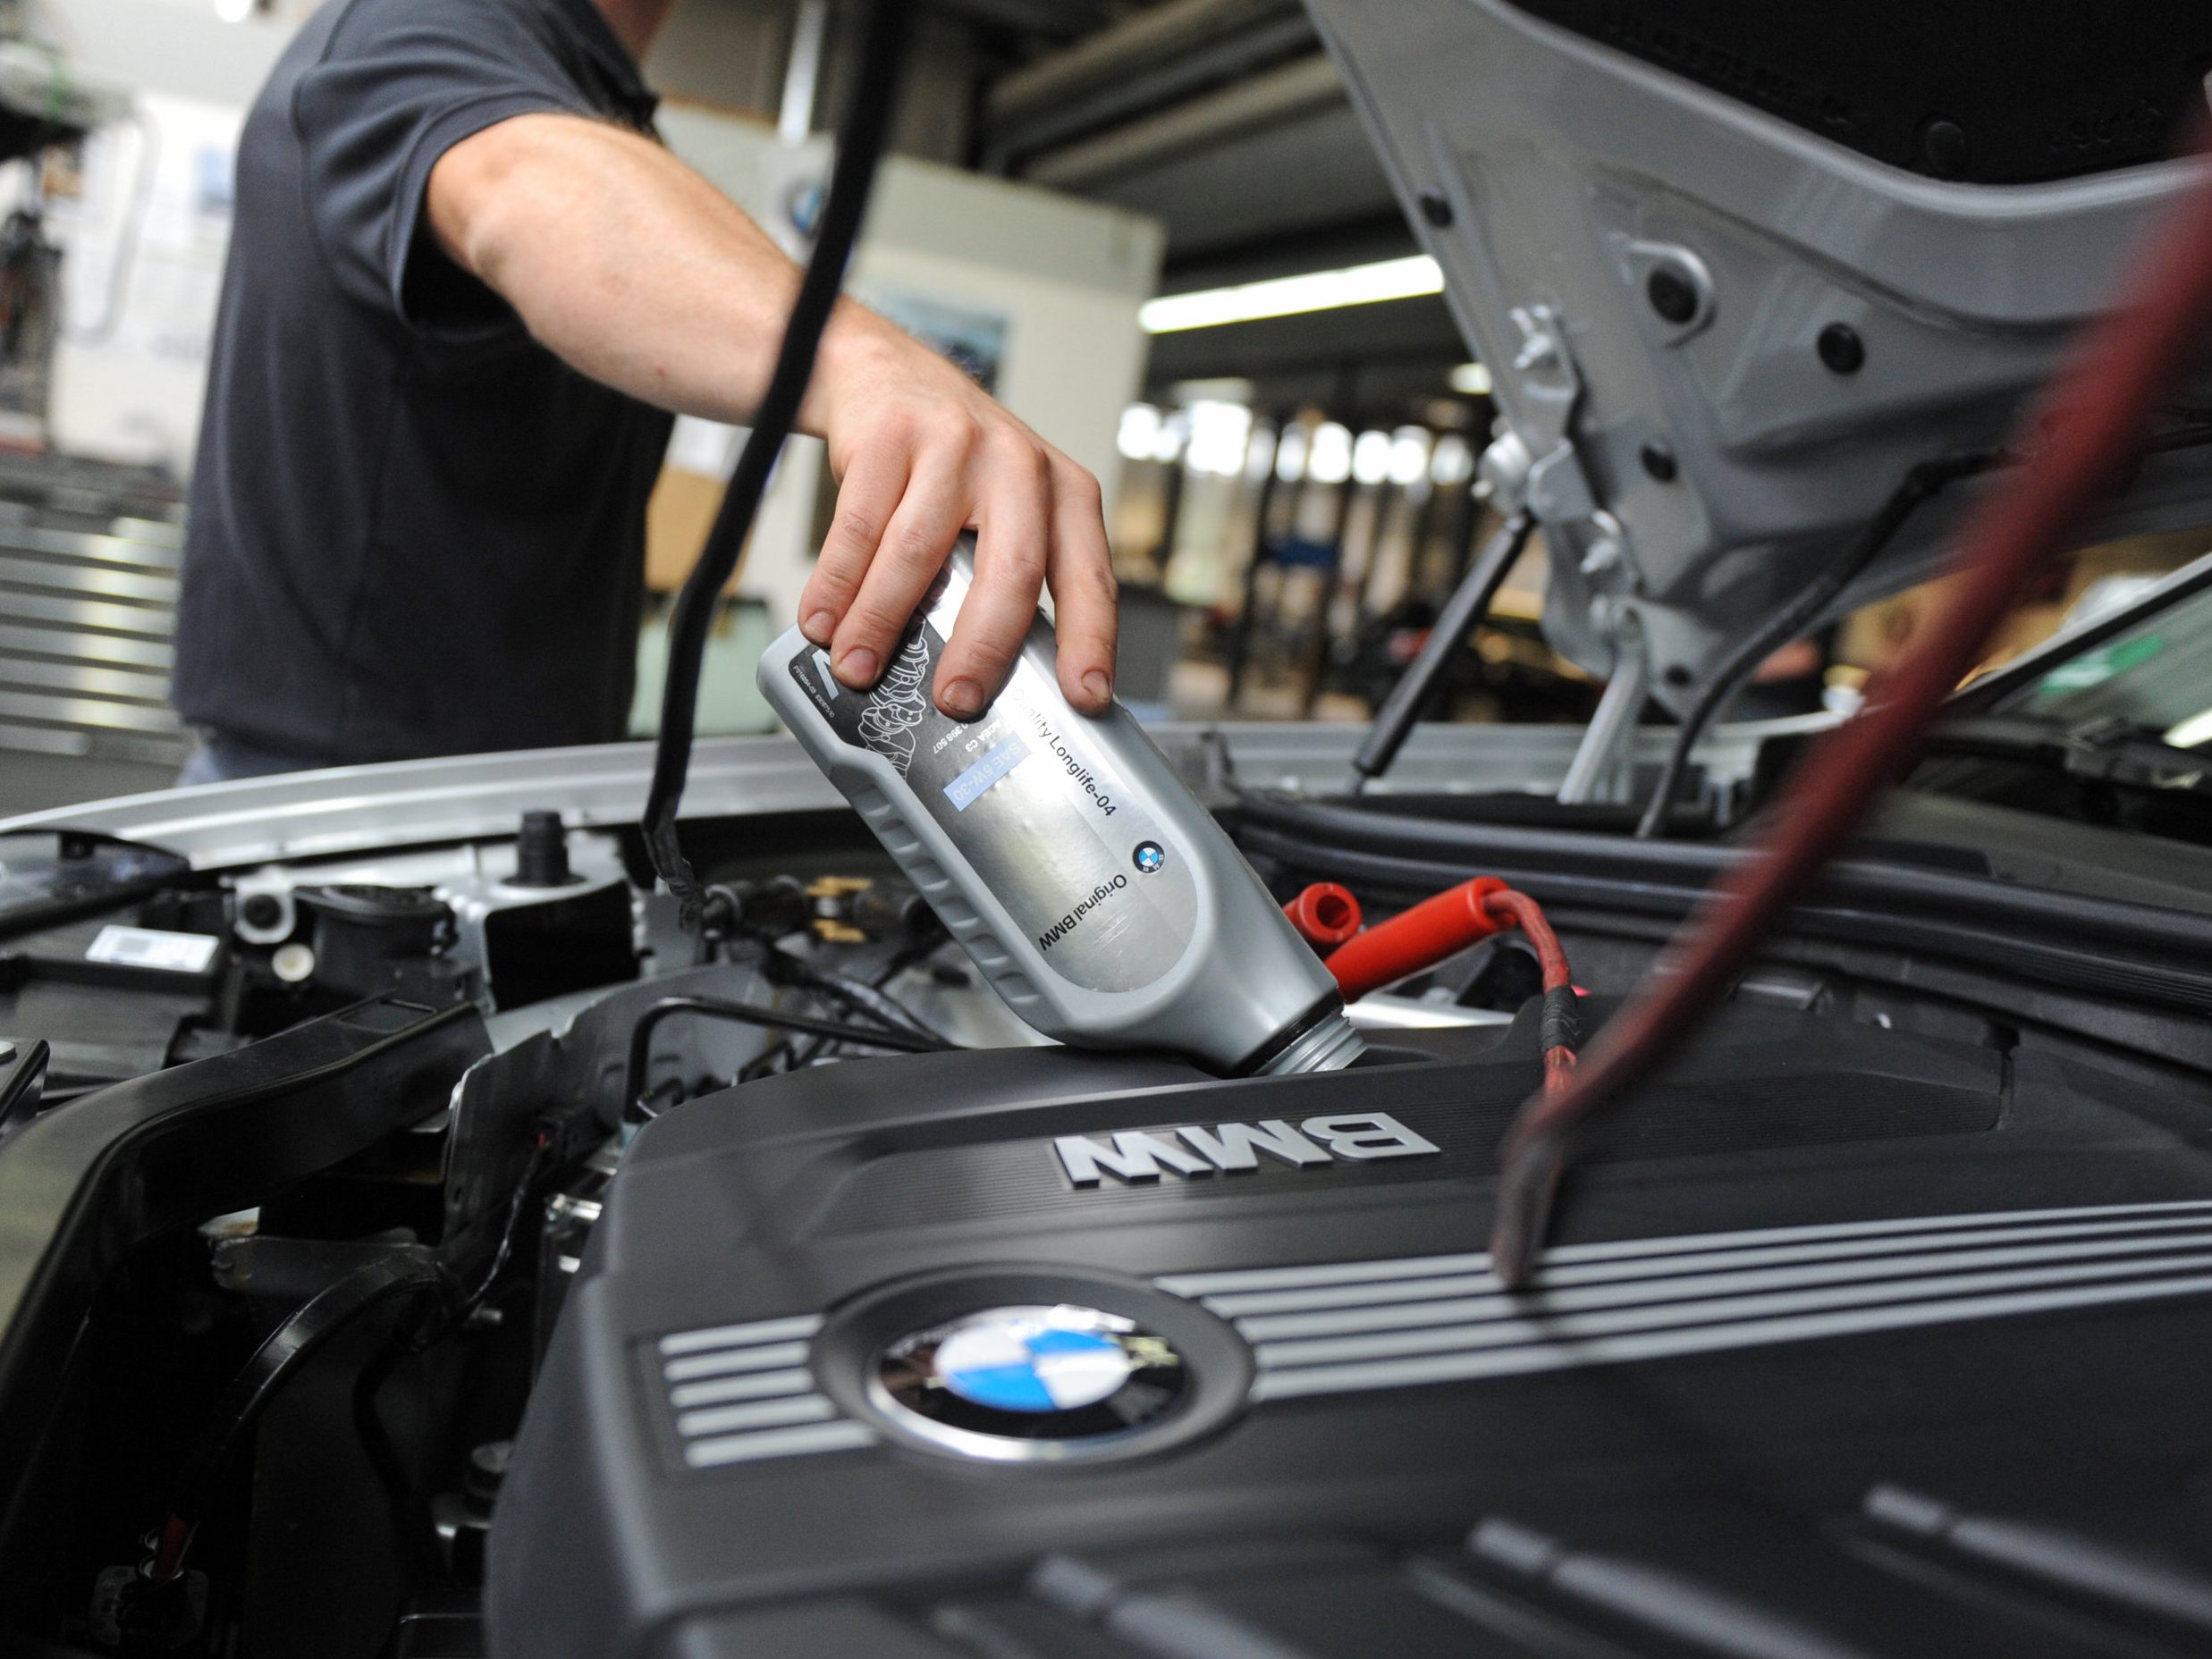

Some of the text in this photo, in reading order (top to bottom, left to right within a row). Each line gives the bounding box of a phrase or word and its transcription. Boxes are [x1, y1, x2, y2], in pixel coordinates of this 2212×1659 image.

[933, 738, 948, 754] 507
[947, 725, 963, 742] 398
[966, 719, 1000, 752] ACEA C3
[1012, 688, 1116, 816] Qality Longlife-04
[953, 743, 1020, 801] SAE 5W-30
[1038, 874, 1127, 951] Original BMW
[1054, 1112, 1441, 1189] BMW
